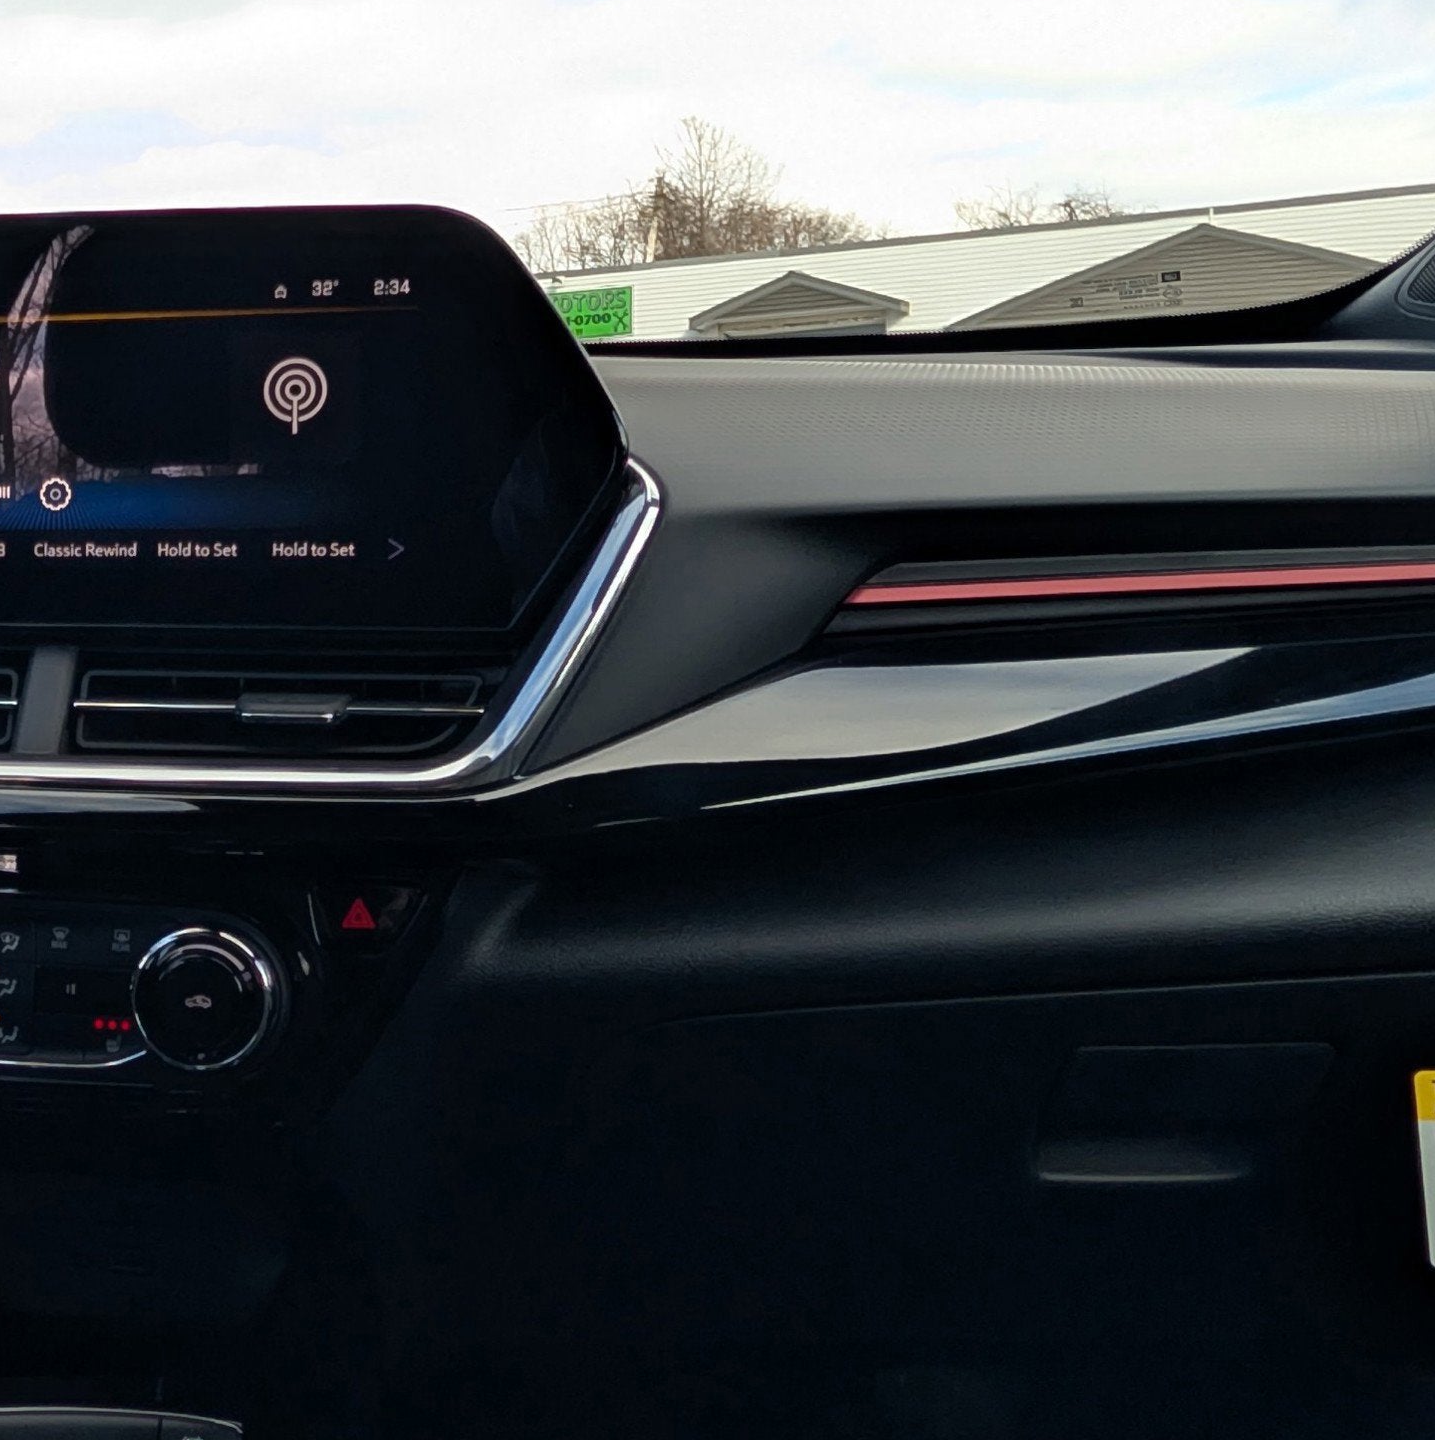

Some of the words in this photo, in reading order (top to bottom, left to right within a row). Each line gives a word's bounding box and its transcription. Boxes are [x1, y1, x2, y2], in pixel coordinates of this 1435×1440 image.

[373, 278, 410, 296] 2:34
[554, 290, 627, 314] OTORS
[34, 542, 82, 558] Classic
[85, 542, 138, 558] Rewind
[157, 542, 192, 558] Hold
[194, 544, 211, 558] to
[213, 542, 238, 558] Set
[272, 542, 308, 558] Hold
[310, 544, 327, 558] to
[330, 542, 355, 558] Set
